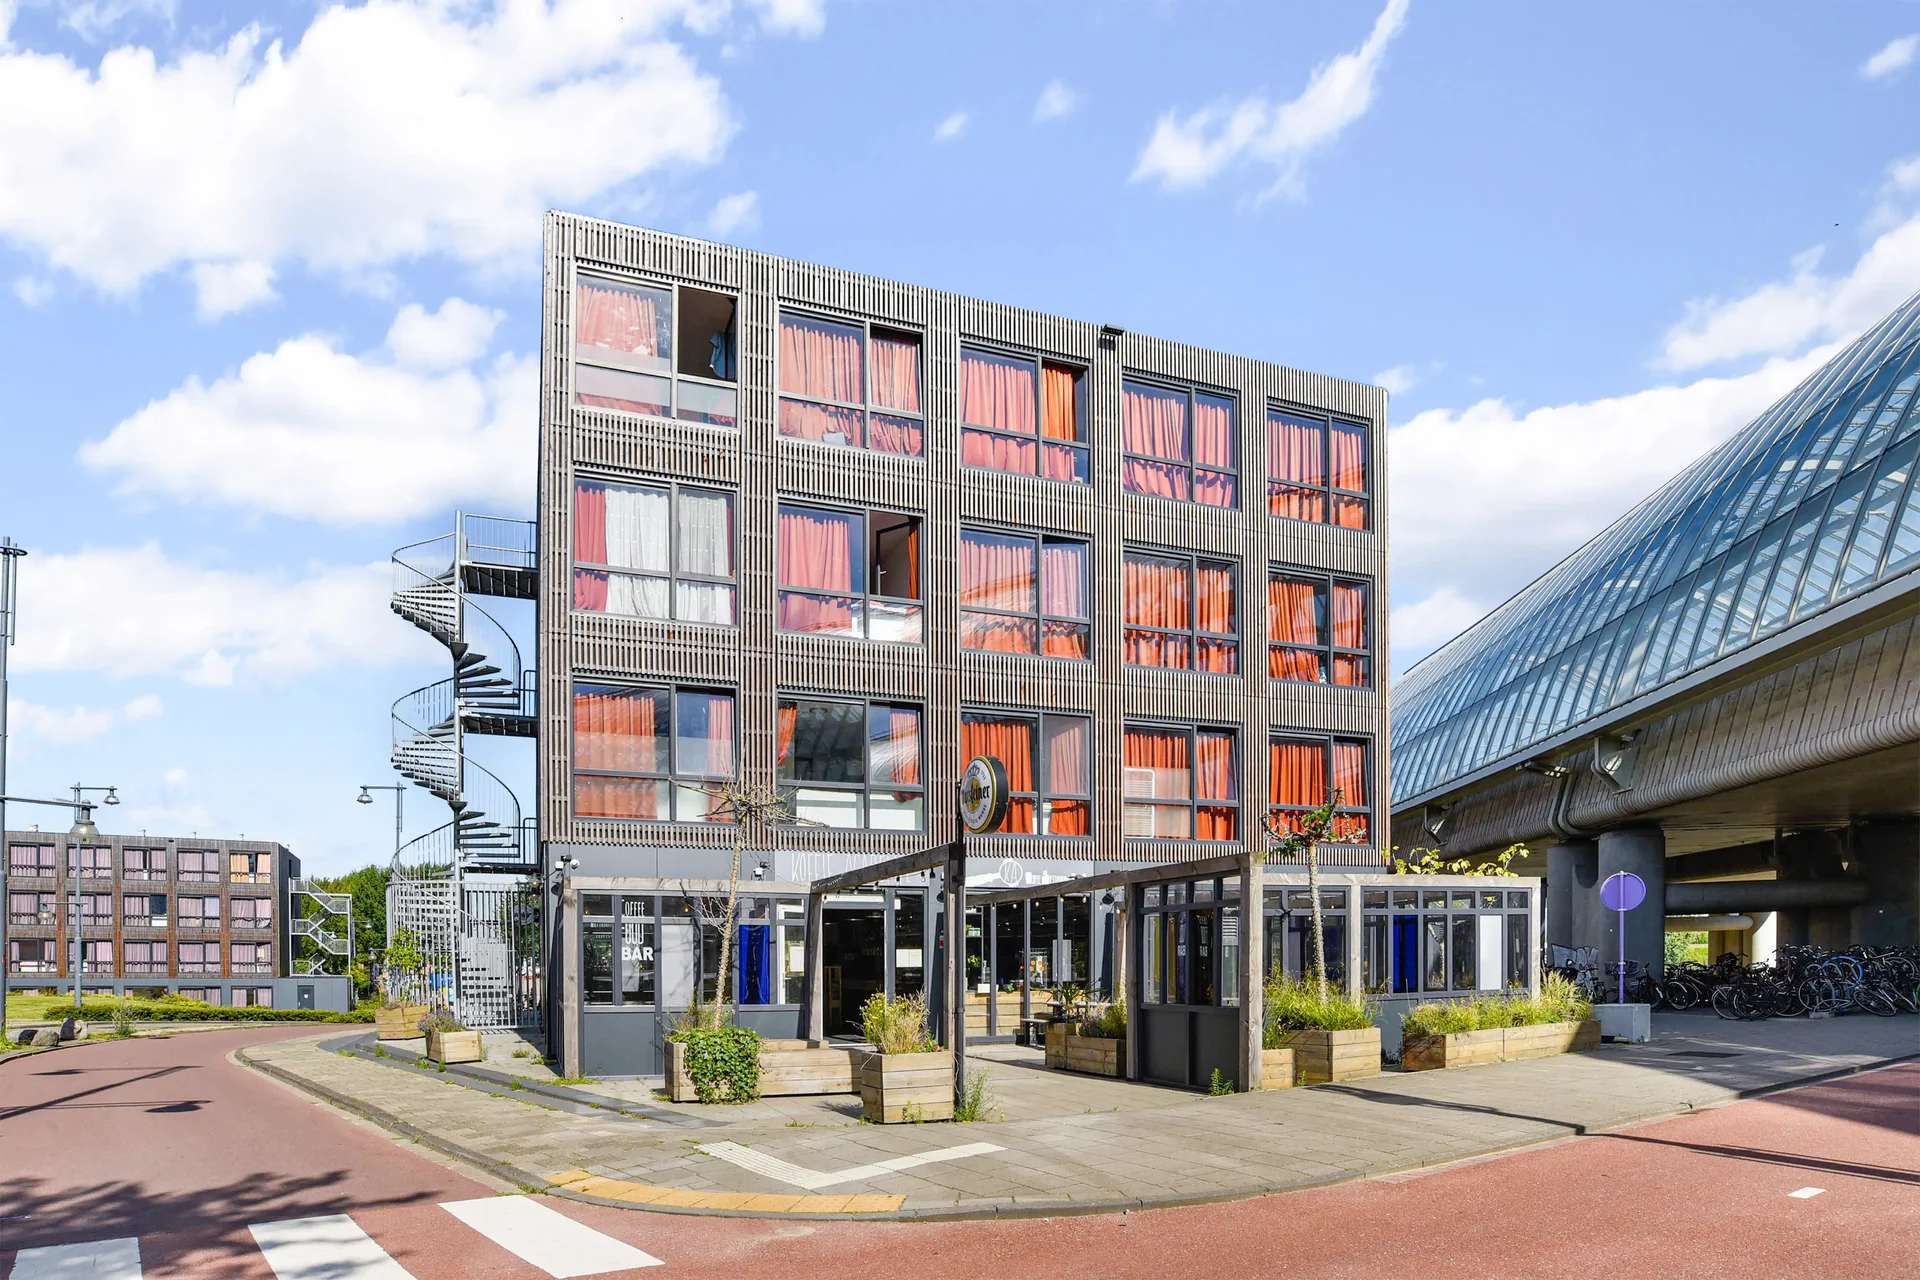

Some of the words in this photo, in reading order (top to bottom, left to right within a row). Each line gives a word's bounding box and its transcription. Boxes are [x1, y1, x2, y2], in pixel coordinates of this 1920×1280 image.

[791, 853, 832, 882] KOFFIE
[621, 899, 645, 918] OFFEE
[621, 946, 654, 961] BAR
